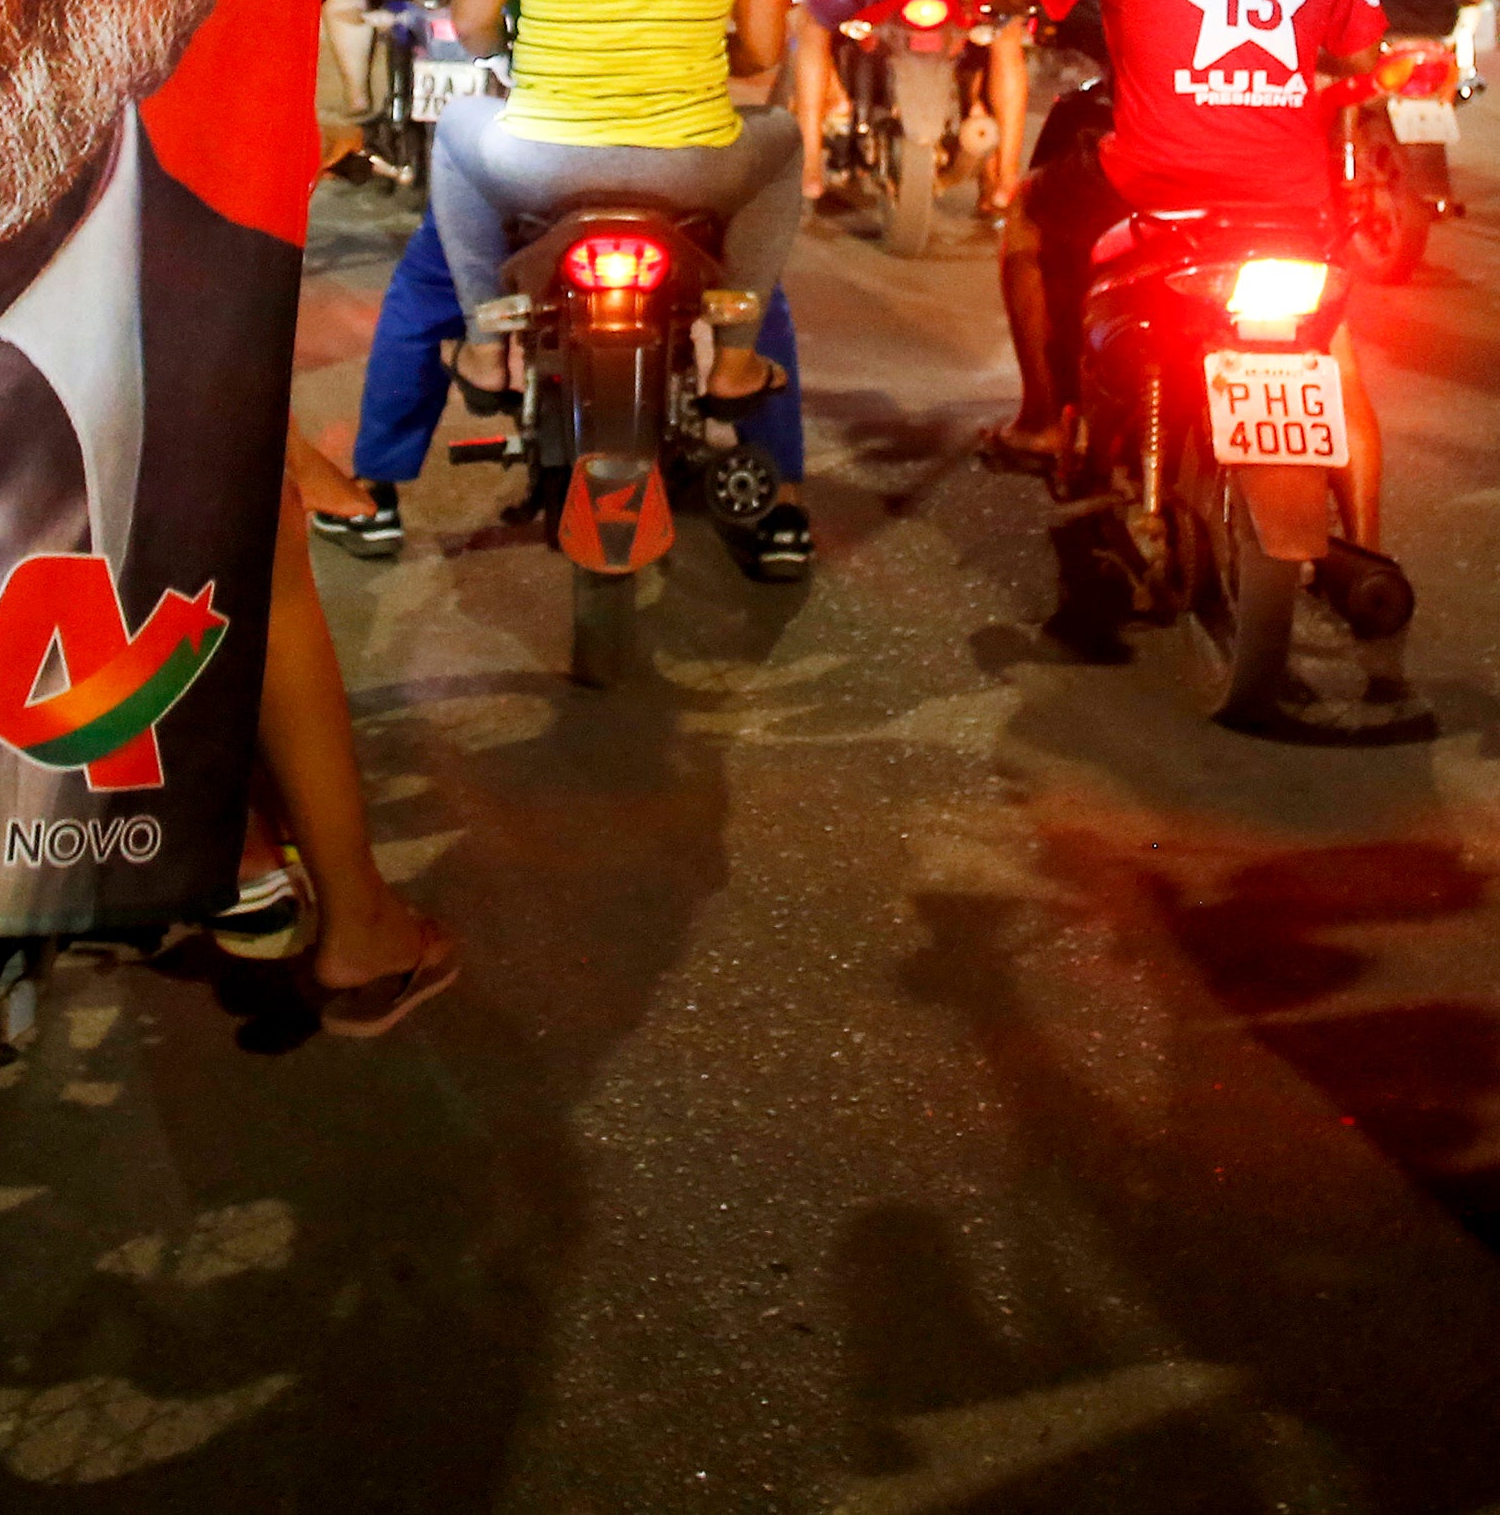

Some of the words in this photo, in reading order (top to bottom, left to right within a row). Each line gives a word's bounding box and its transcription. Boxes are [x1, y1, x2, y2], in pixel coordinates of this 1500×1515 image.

[1174, 69, 1308, 97] LULA
[1226, 382, 1324, 416] PHG
[1229, 420, 1334, 456] 4003
[4, 814, 161, 867] NOVO
